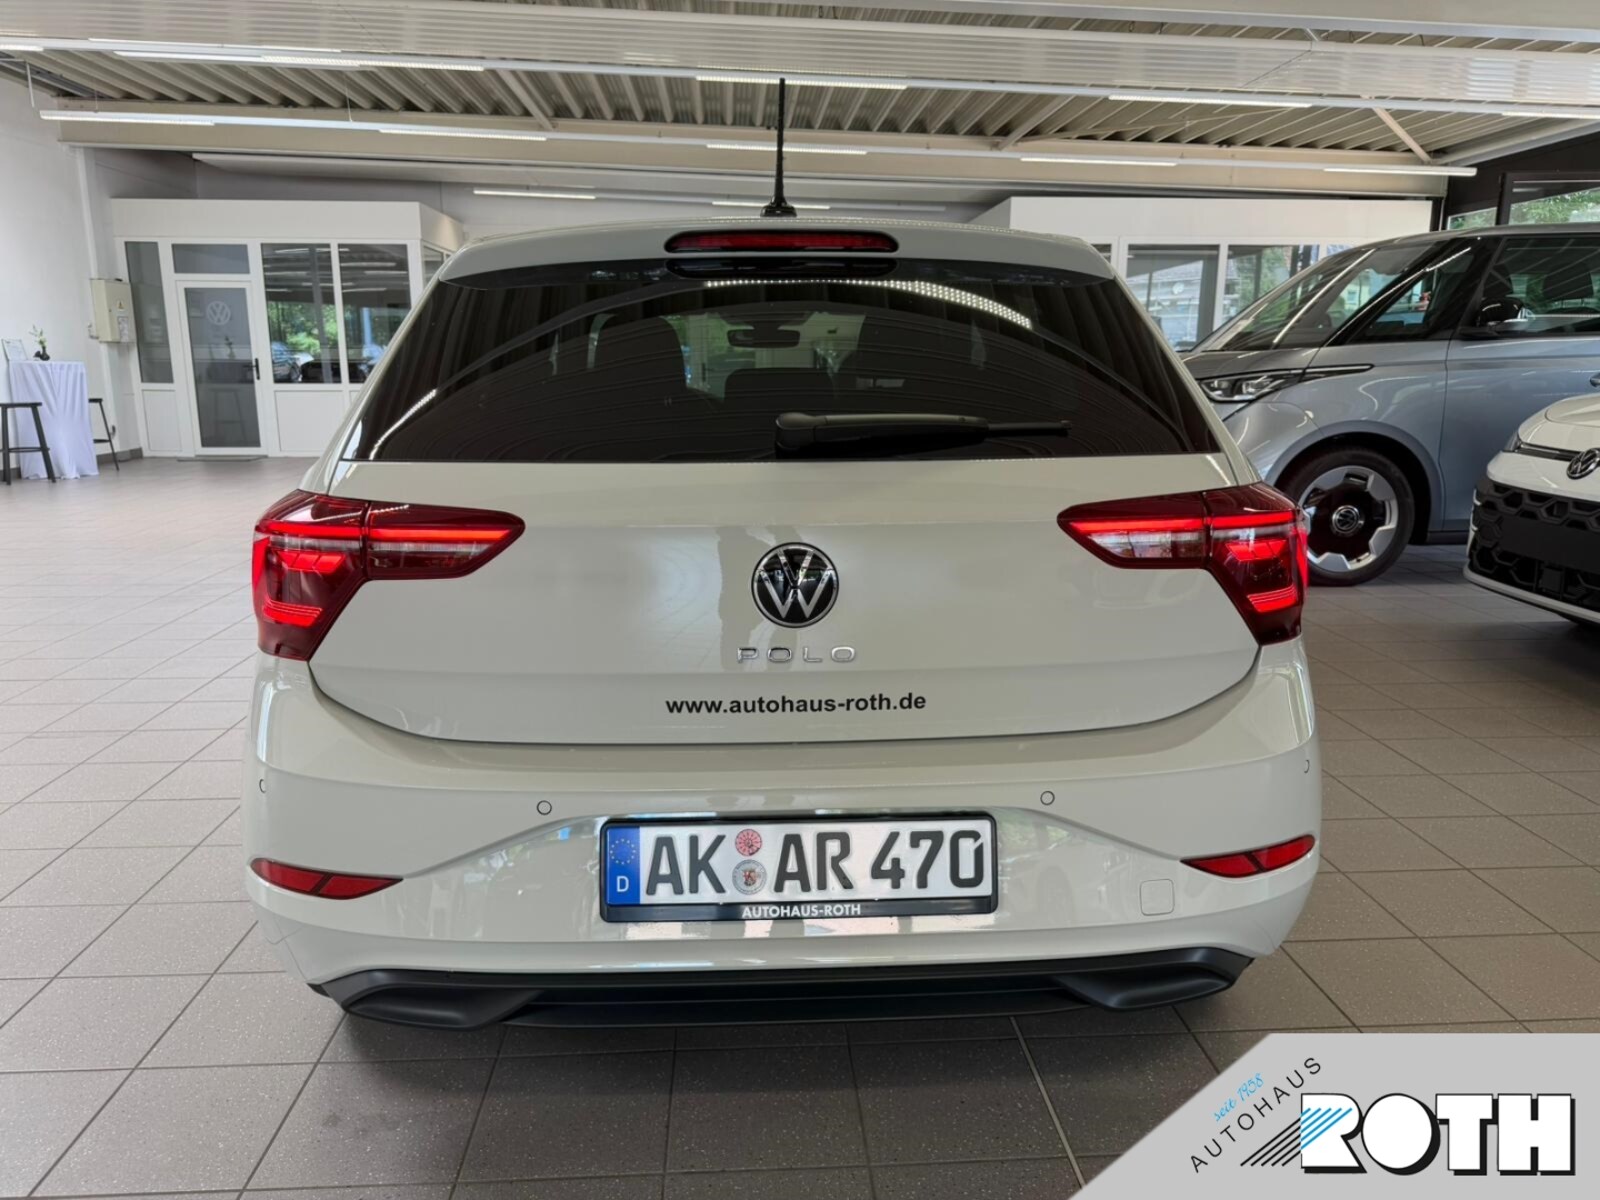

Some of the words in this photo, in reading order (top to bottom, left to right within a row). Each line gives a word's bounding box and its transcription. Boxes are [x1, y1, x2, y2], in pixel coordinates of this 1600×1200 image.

[737, 646, 856, 664] POLO
[665, 693, 927, 714] www.autohaus-roth.de
[645, 834, 726, 896] AK
[773, 831, 854, 892] AR
[870, 829, 985, 889] 470
[616, 875, 630, 893] D
[741, 903, 862, 919] AUTOHAUS-ROTH
